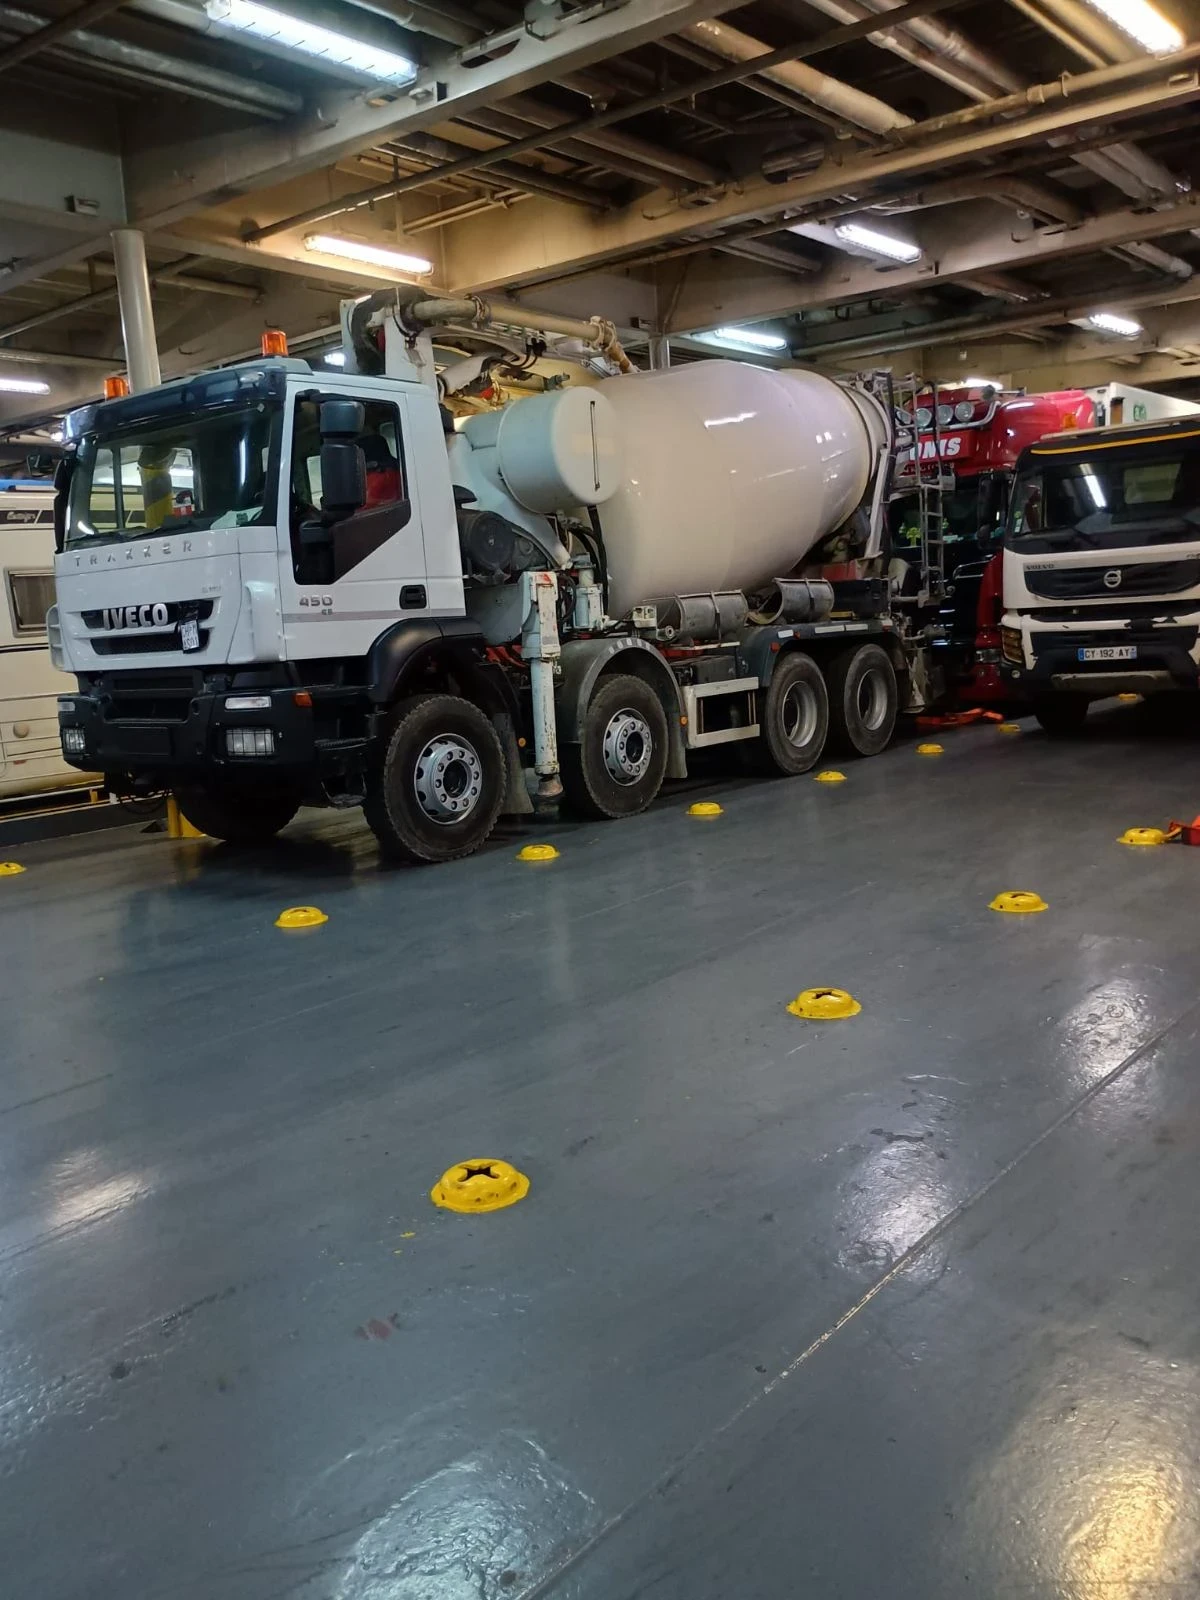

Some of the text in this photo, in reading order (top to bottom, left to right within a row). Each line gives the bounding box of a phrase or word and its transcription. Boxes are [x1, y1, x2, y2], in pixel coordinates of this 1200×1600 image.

[73, 538, 193, 568] TRAKKER
[299, 594, 334, 607] 450
[102, 602, 169, 631] IVECO
